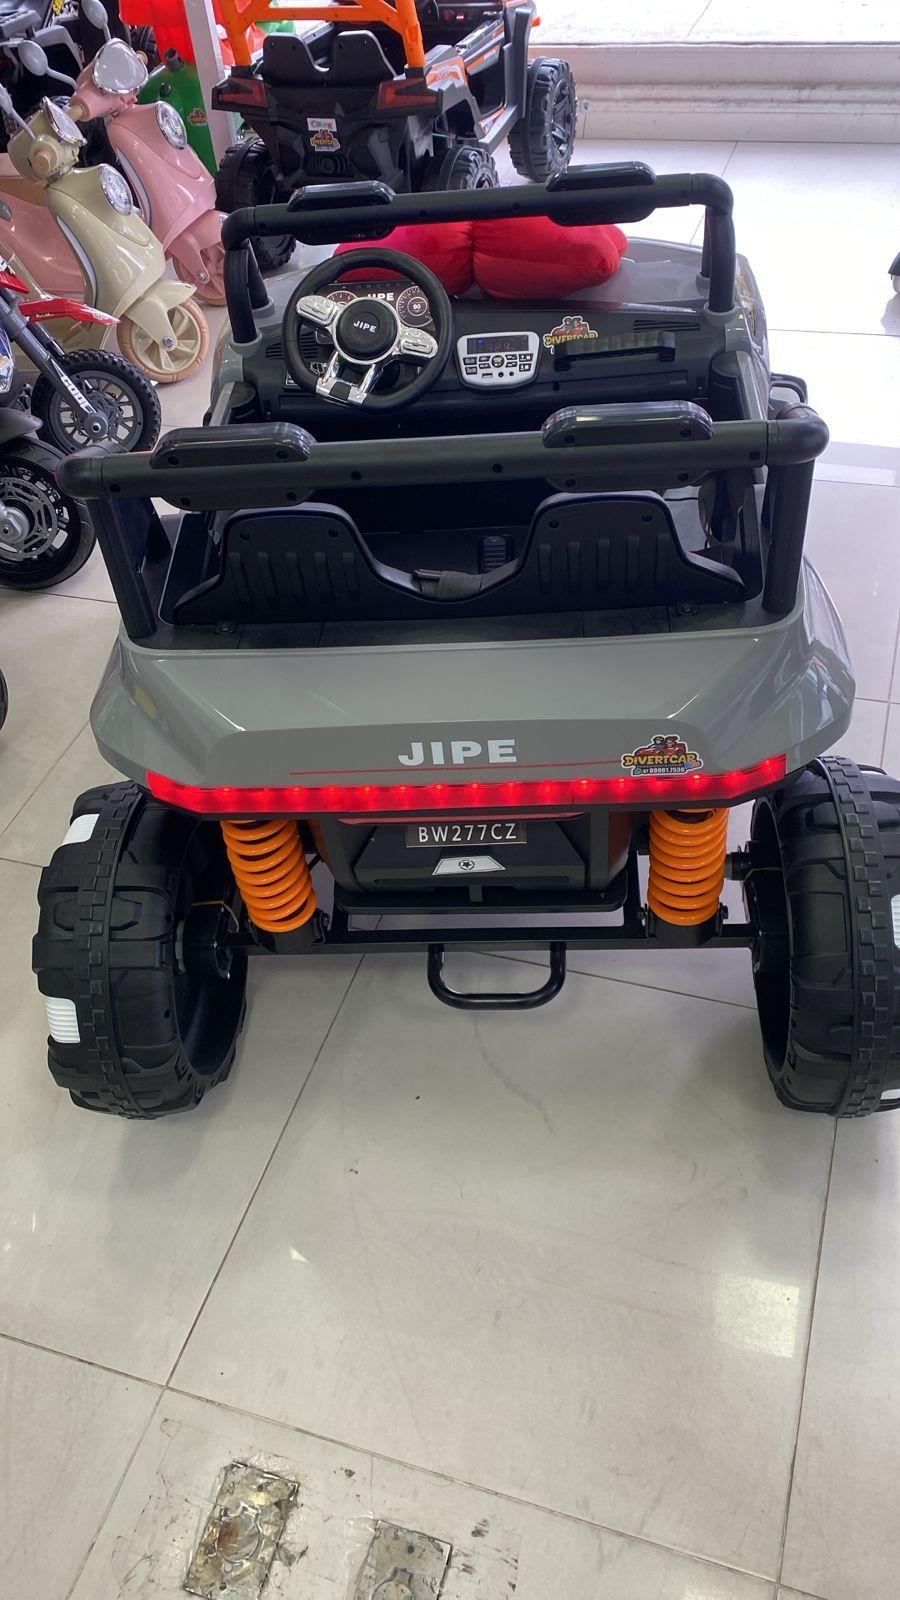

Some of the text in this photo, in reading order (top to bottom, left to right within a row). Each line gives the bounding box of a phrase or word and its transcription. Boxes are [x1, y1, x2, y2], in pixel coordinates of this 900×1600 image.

[353, 320, 377, 333] JIPE
[398, 739, 518, 766] JIPE
[624, 754, 695, 765] DIVERTCAR
[418, 823, 517, 843] BW277CZ
